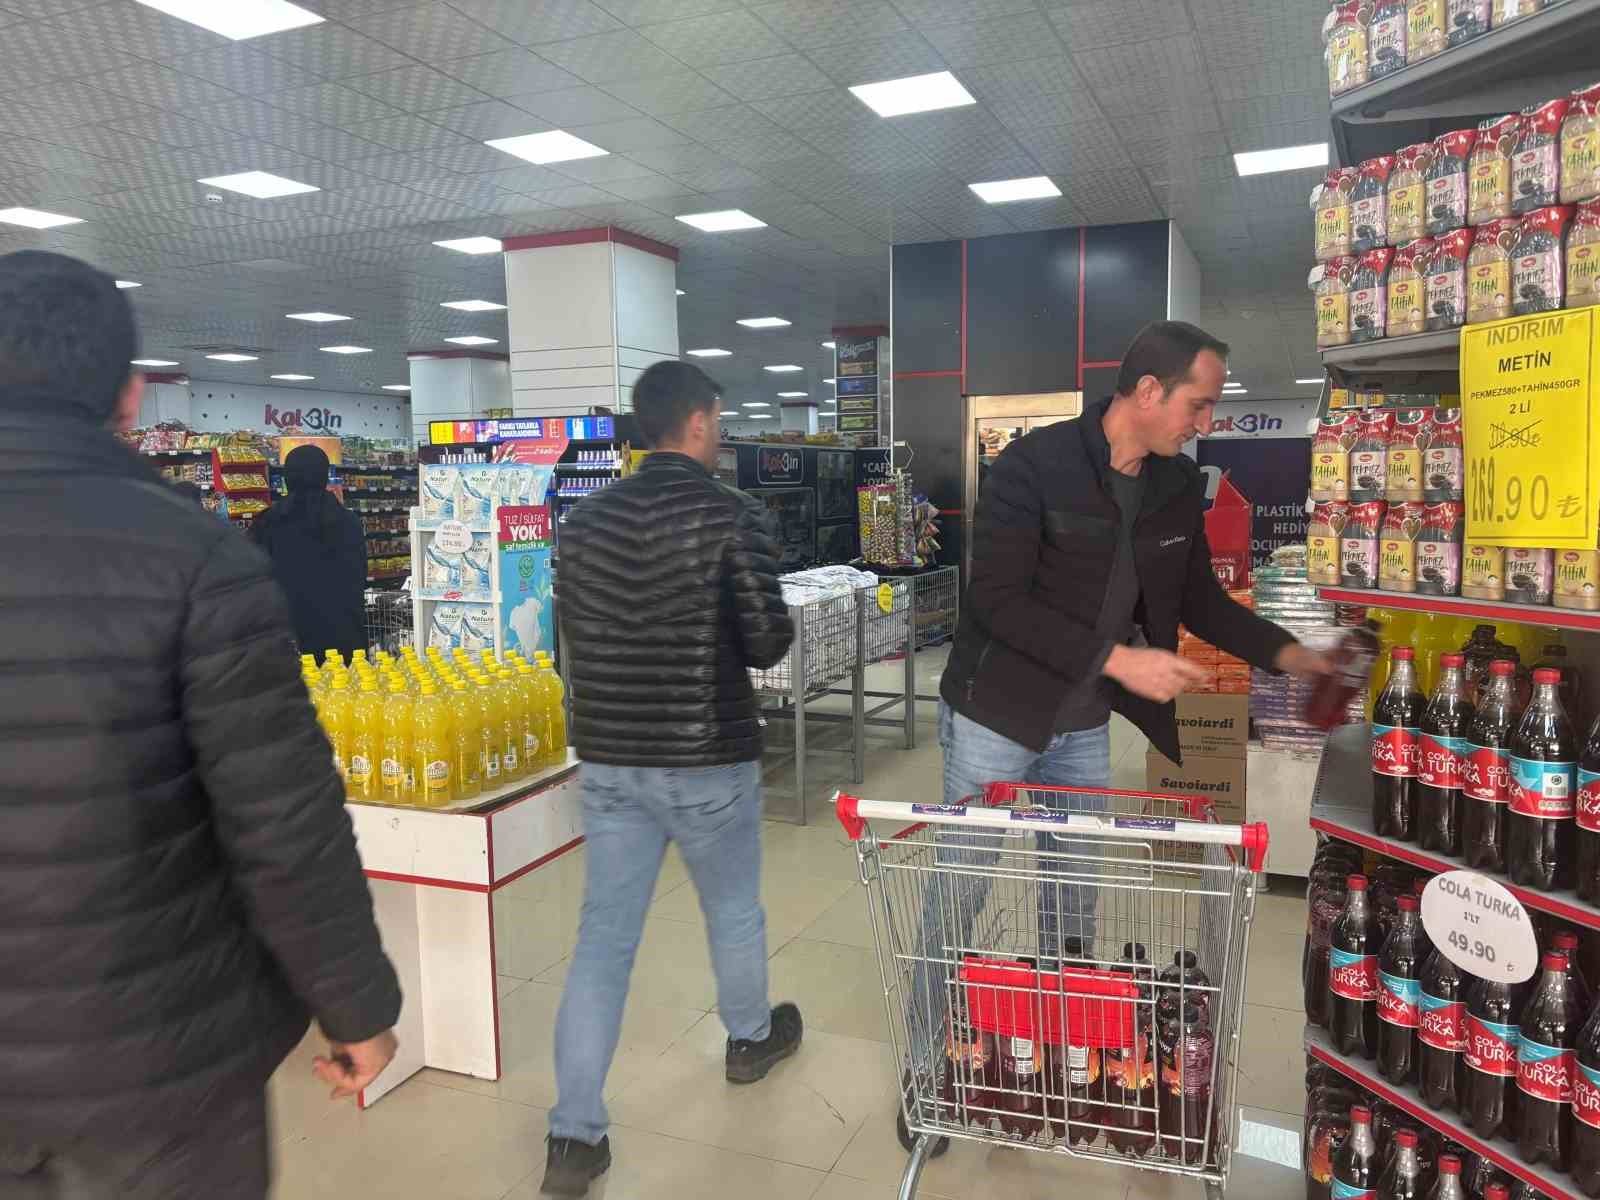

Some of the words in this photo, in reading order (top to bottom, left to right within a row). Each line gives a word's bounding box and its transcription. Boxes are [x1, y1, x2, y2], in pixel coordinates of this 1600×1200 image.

[1498, 350, 1552, 373] METİN
[1510, 403, 1517, 414] 2
[1257, 502, 1304, 517] PLASTİK
[510, 524, 542, 541] YOK!
[1176, 717, 1234, 729] avoiardi
[1427, 751, 1457, 763] COLA
[1428, 759, 1465, 775] TURK
[1160, 777, 1232, 792] Savoiardi
[1438, 878, 1471, 902] COLA
[1474, 891, 1521, 921] TURKA
[1447, 930, 1496, 963] 49.90
[1341, 966, 1368, 977] COLA
[1425, 1011, 1453, 1024] COLA
[1475, 1035, 1505, 1049] COLA
[1476, 1044, 1516, 1062] TURK
[1535, 1062, 1568, 1074] COLA
